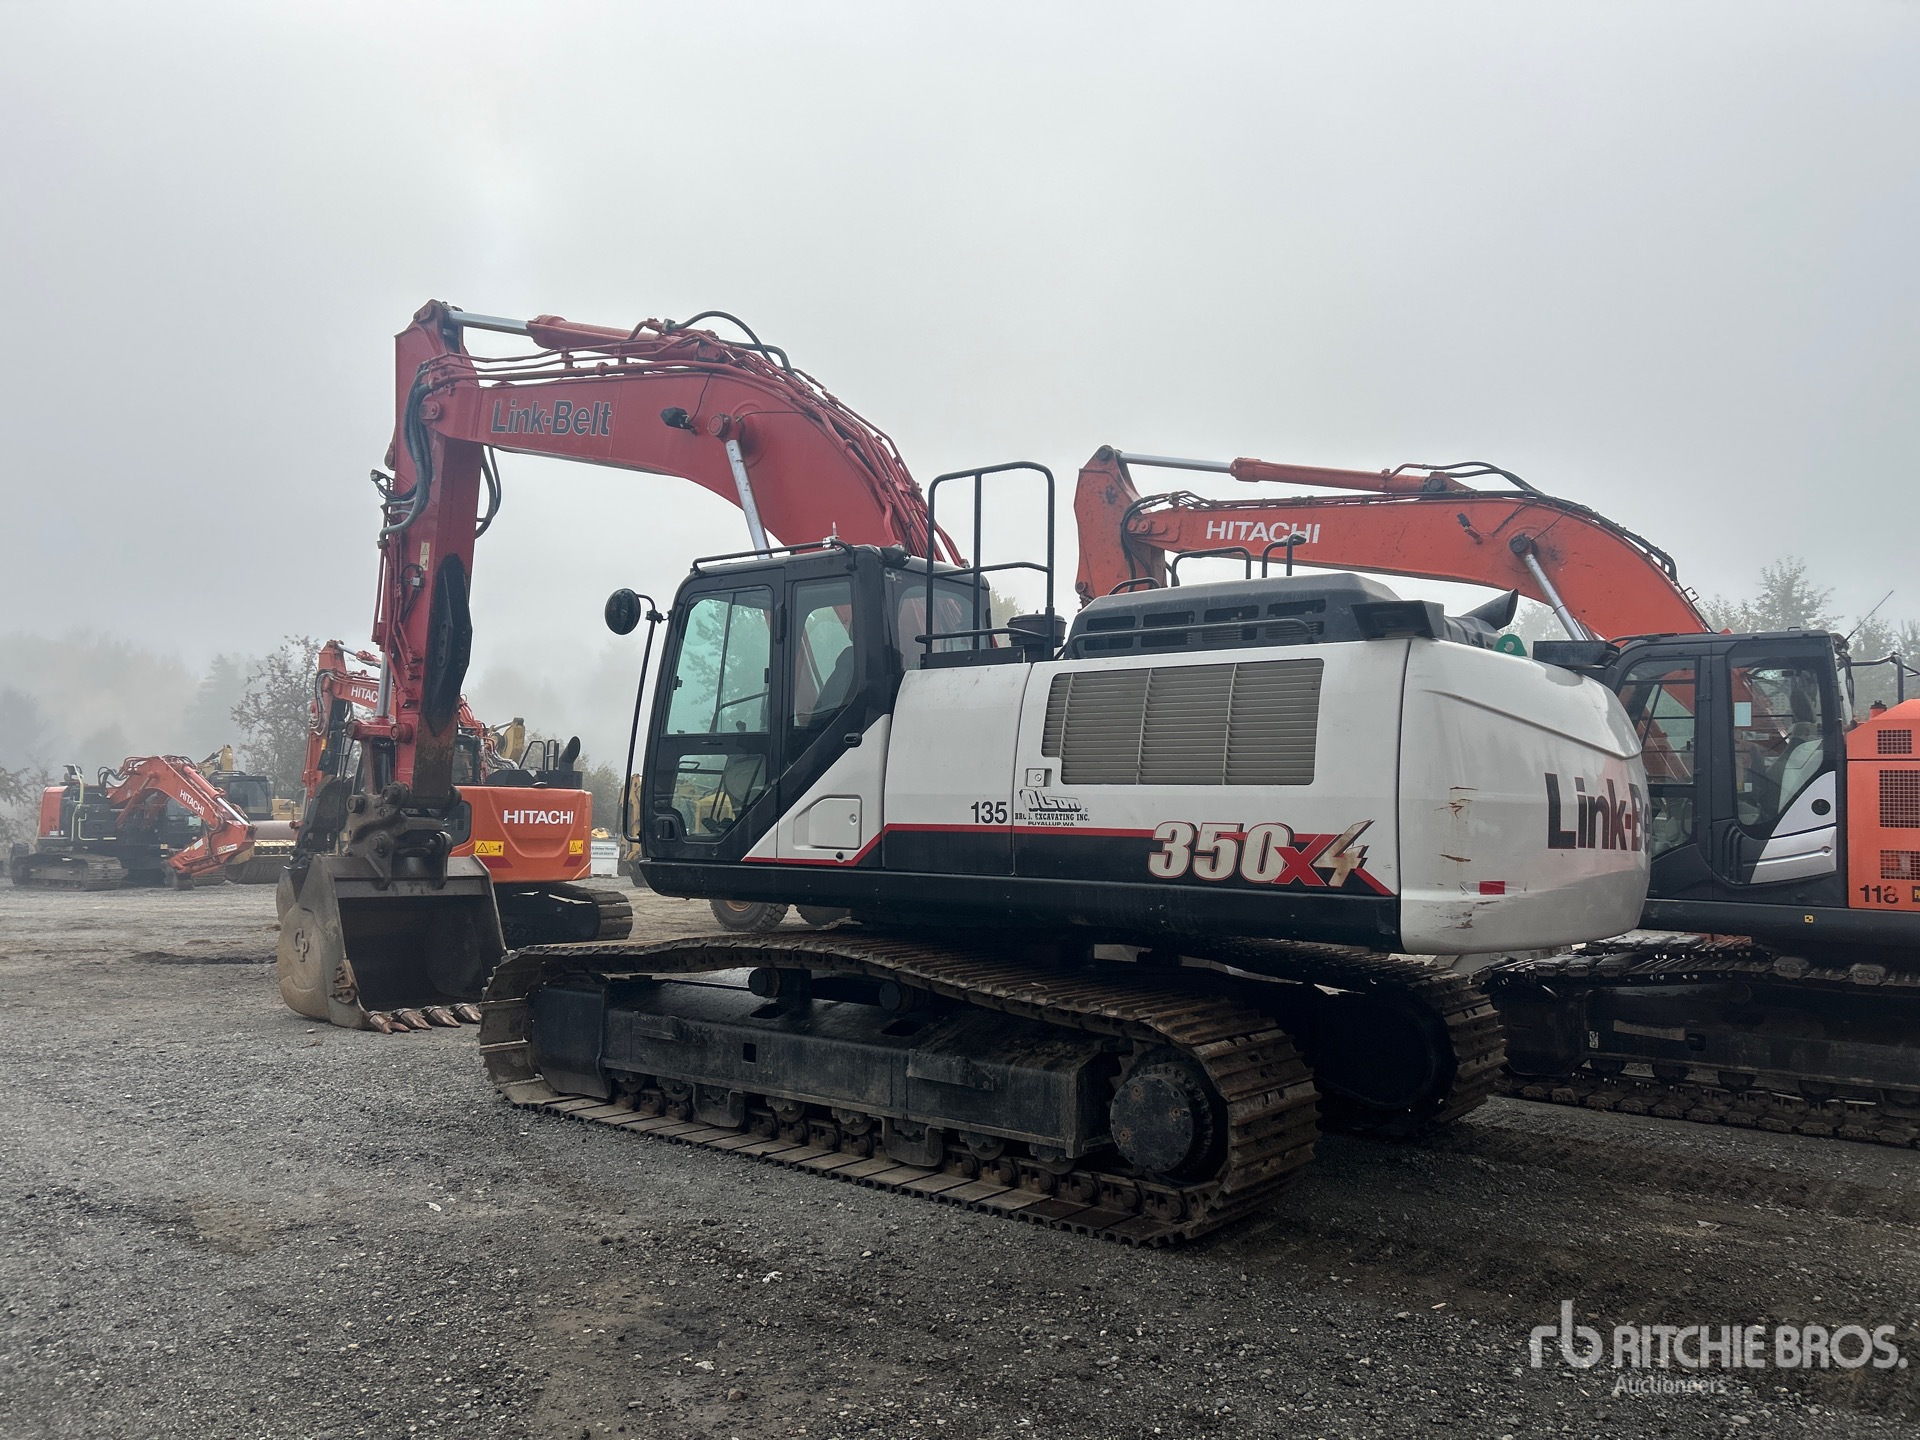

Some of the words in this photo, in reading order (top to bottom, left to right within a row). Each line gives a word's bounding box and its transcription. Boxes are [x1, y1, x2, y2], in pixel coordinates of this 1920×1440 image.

[491, 399, 612, 436] Link-Belt
[1205, 520, 1321, 544] HITACHI
[351, 686, 378, 703] HITAC
[180, 789, 205, 816] HITACHI
[970, 801, 1008, 824] 135
[503, 809, 574, 825] HITACHI
[1035, 812, 1075, 821] EXCAVATING
